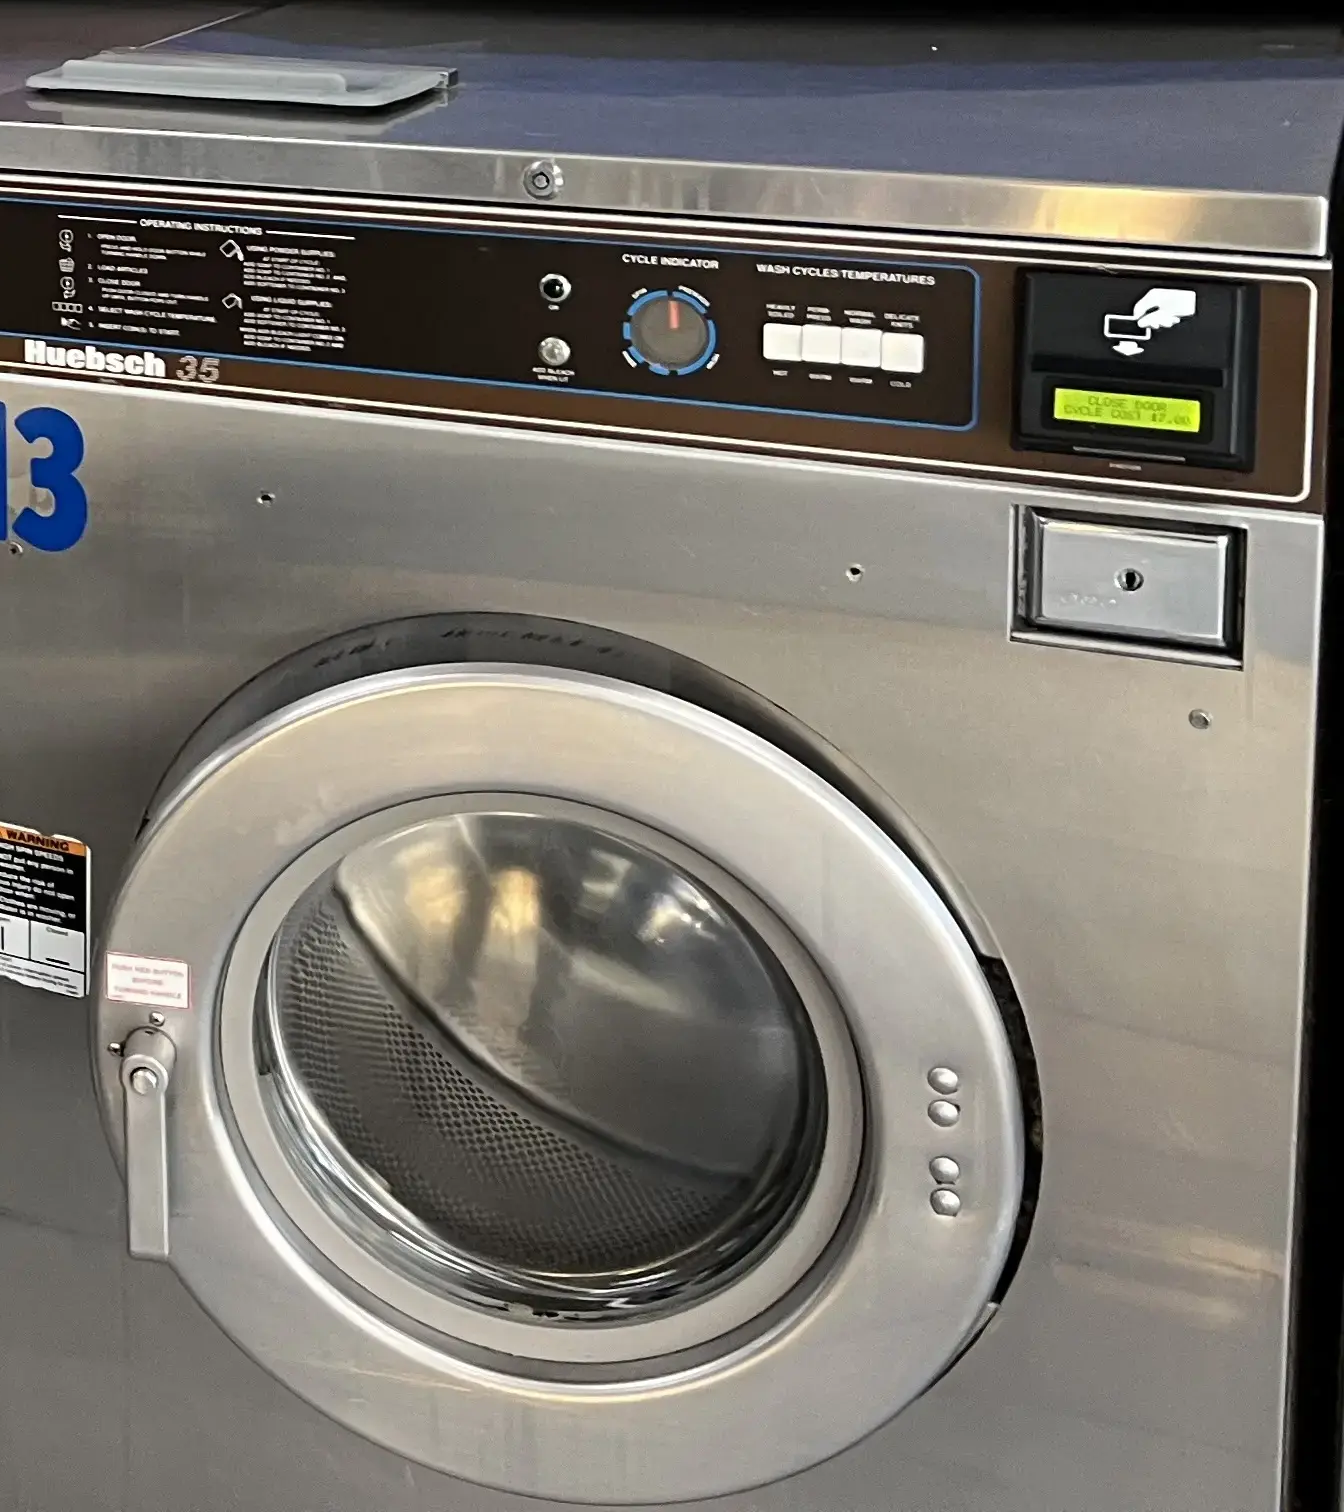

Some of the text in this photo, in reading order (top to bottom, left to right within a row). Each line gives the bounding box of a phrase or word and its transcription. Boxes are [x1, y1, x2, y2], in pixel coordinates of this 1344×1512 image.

[23, 339, 223, 385] Huebsch 35
[5, 829, 71, 852] WARNING
